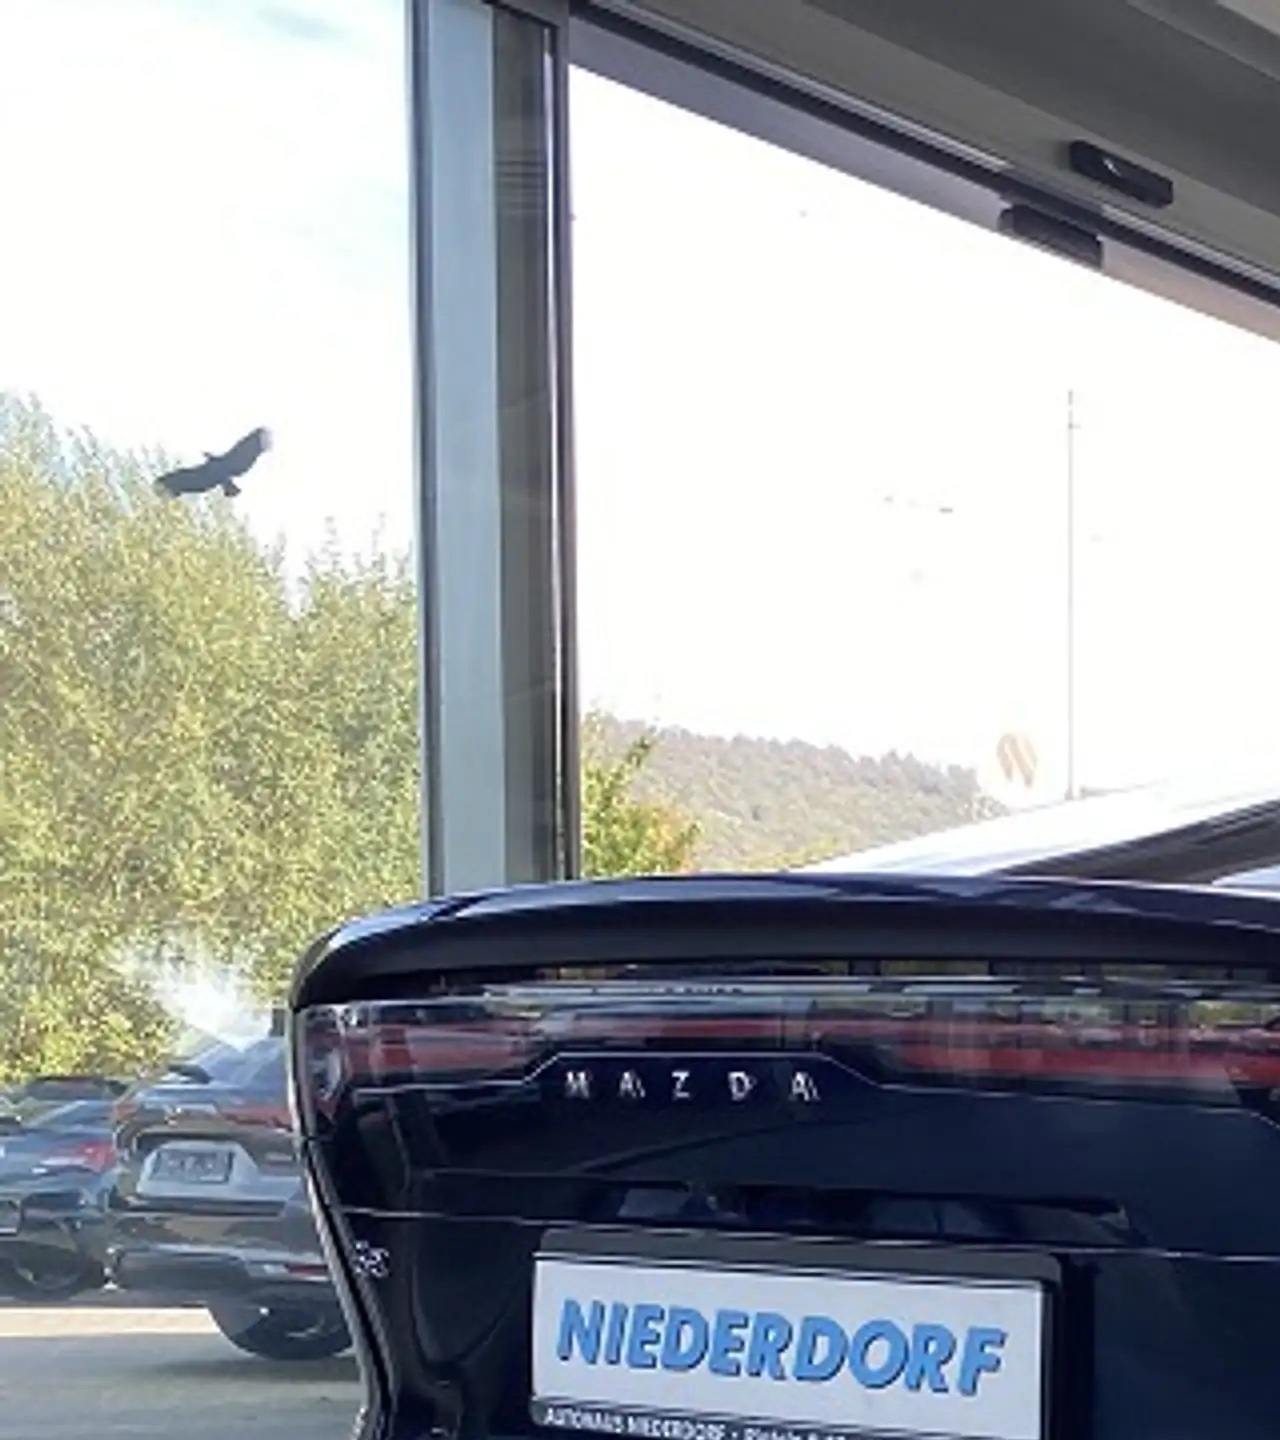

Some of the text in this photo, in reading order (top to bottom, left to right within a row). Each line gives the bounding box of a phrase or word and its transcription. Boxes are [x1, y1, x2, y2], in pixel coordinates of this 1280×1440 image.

[564, 1070, 820, 1101] MAZDA
[556, 1298, 1008, 1396] NIEDERDORF
[542, 1406, 625, 1434] AUTOHAUS
